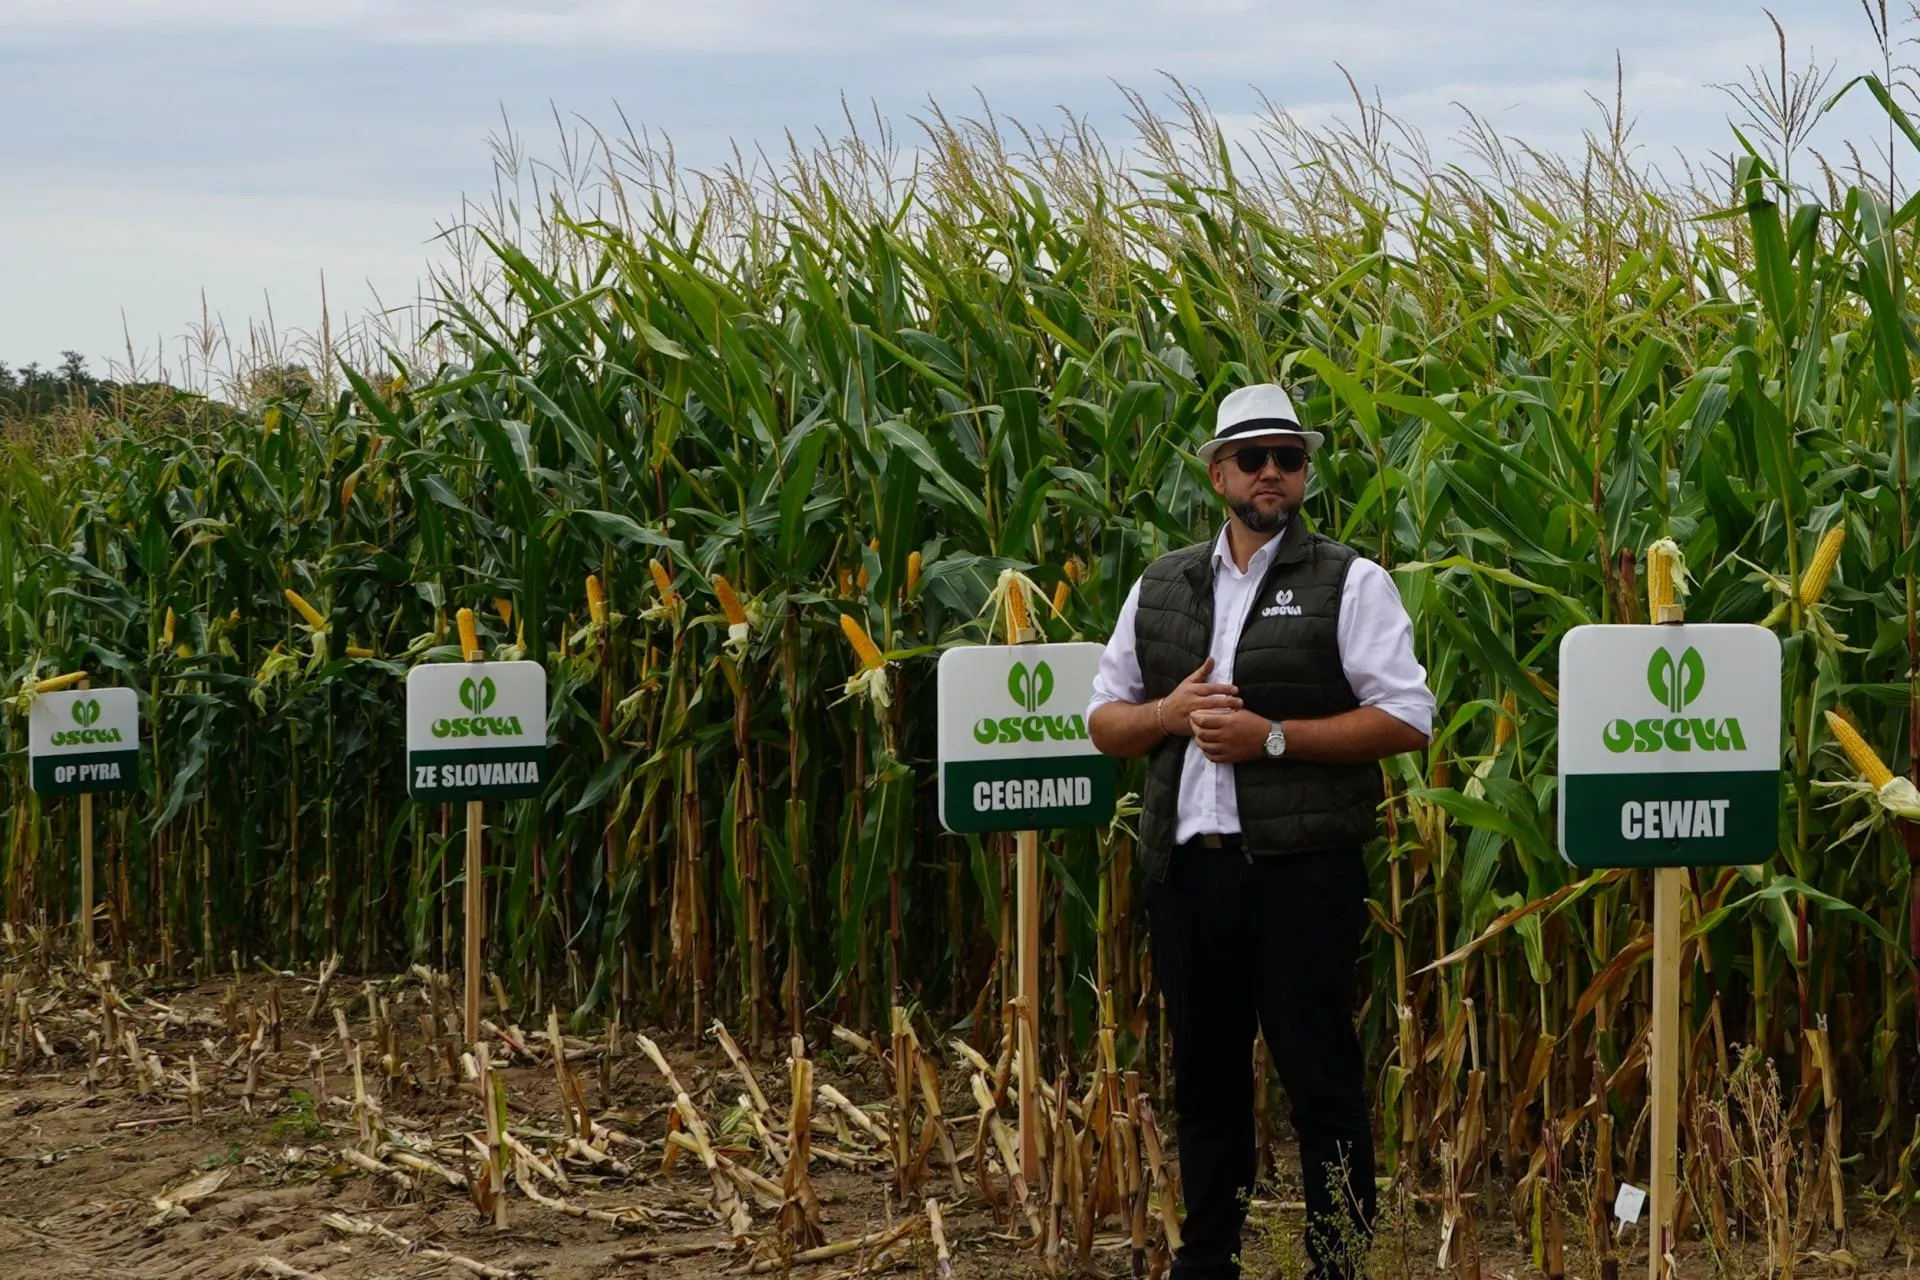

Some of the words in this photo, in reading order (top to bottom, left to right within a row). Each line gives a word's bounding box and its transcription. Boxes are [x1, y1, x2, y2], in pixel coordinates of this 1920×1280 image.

[55, 766, 77, 784] OP
[79, 763, 121, 782] PYRA
[414, 765, 437, 788] ZE
[441, 761, 540, 787] SLOVAKIA
[973, 776, 1092, 812] CEGRAND
[1621, 799, 1730, 840] CEWAT
